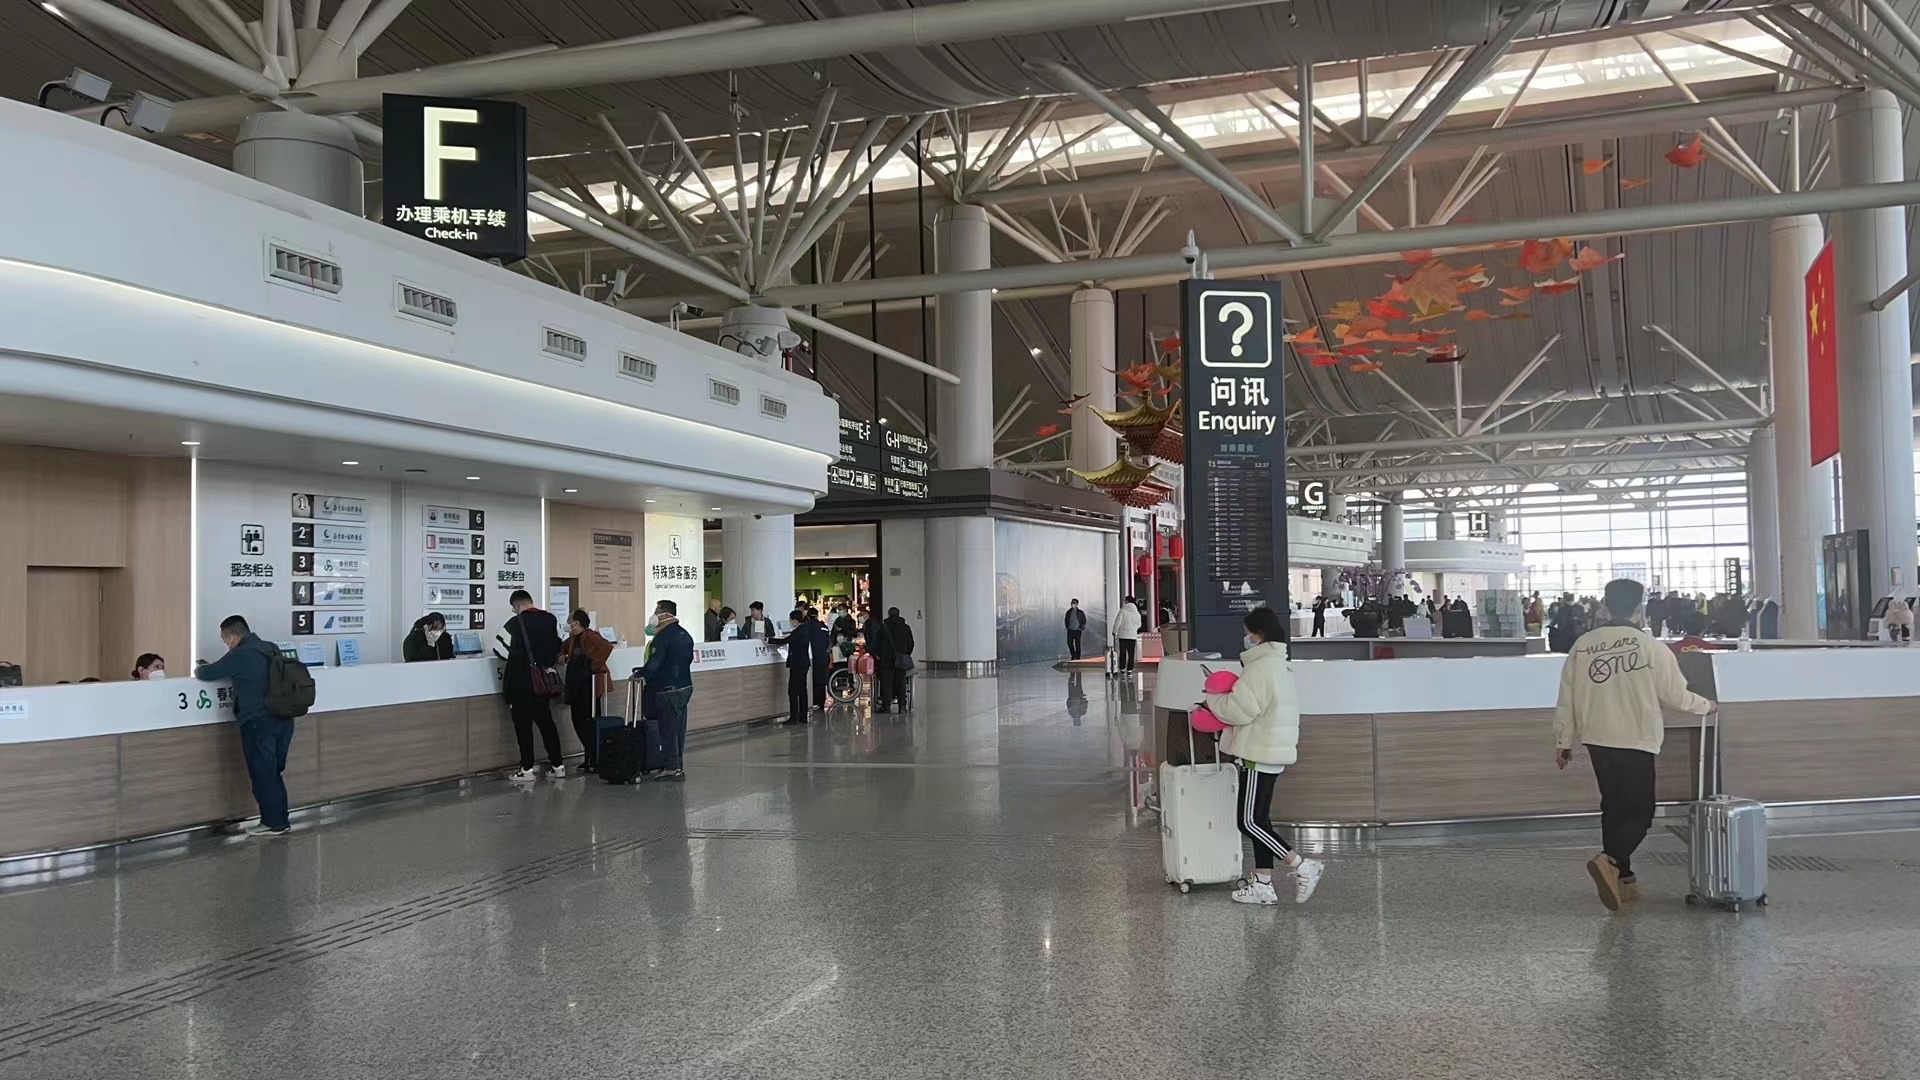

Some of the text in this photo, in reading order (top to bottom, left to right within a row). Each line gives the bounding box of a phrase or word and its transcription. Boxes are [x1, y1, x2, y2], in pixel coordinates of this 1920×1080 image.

[423, 106, 478, 200] F
[396, 204, 506, 228] 办理乘机手续
[424, 227, 478, 240] Check-in
[1210, 376, 1270, 407] 问讯
[1198, 410, 1276, 435] Enquiry
[858, 422, 871, 441] E-F
[885, 430, 900, 449] G-H
[849, 470, 855, 487] 2
[1304, 482, 1324, 505] G
[298, 498, 305, 509] 1
[476, 513, 482, 524] 6
[1471, 513, 1486, 531] H
[298, 526, 306, 539] 2
[476, 537, 482, 548] 7
[298, 556, 306, 568] 3
[476, 562, 482, 573] 8
[230, 563, 274, 578] 服务柜台
[497, 570, 525, 582] 服务柜台
[652, 564, 698, 580] 特殊旅客服务
[298, 586, 306, 598] 4
[476, 587, 482, 598] 9
[298, 615, 306, 627] 5
[474, 612, 484, 623] 10
[178, 692, 189, 710] 3
